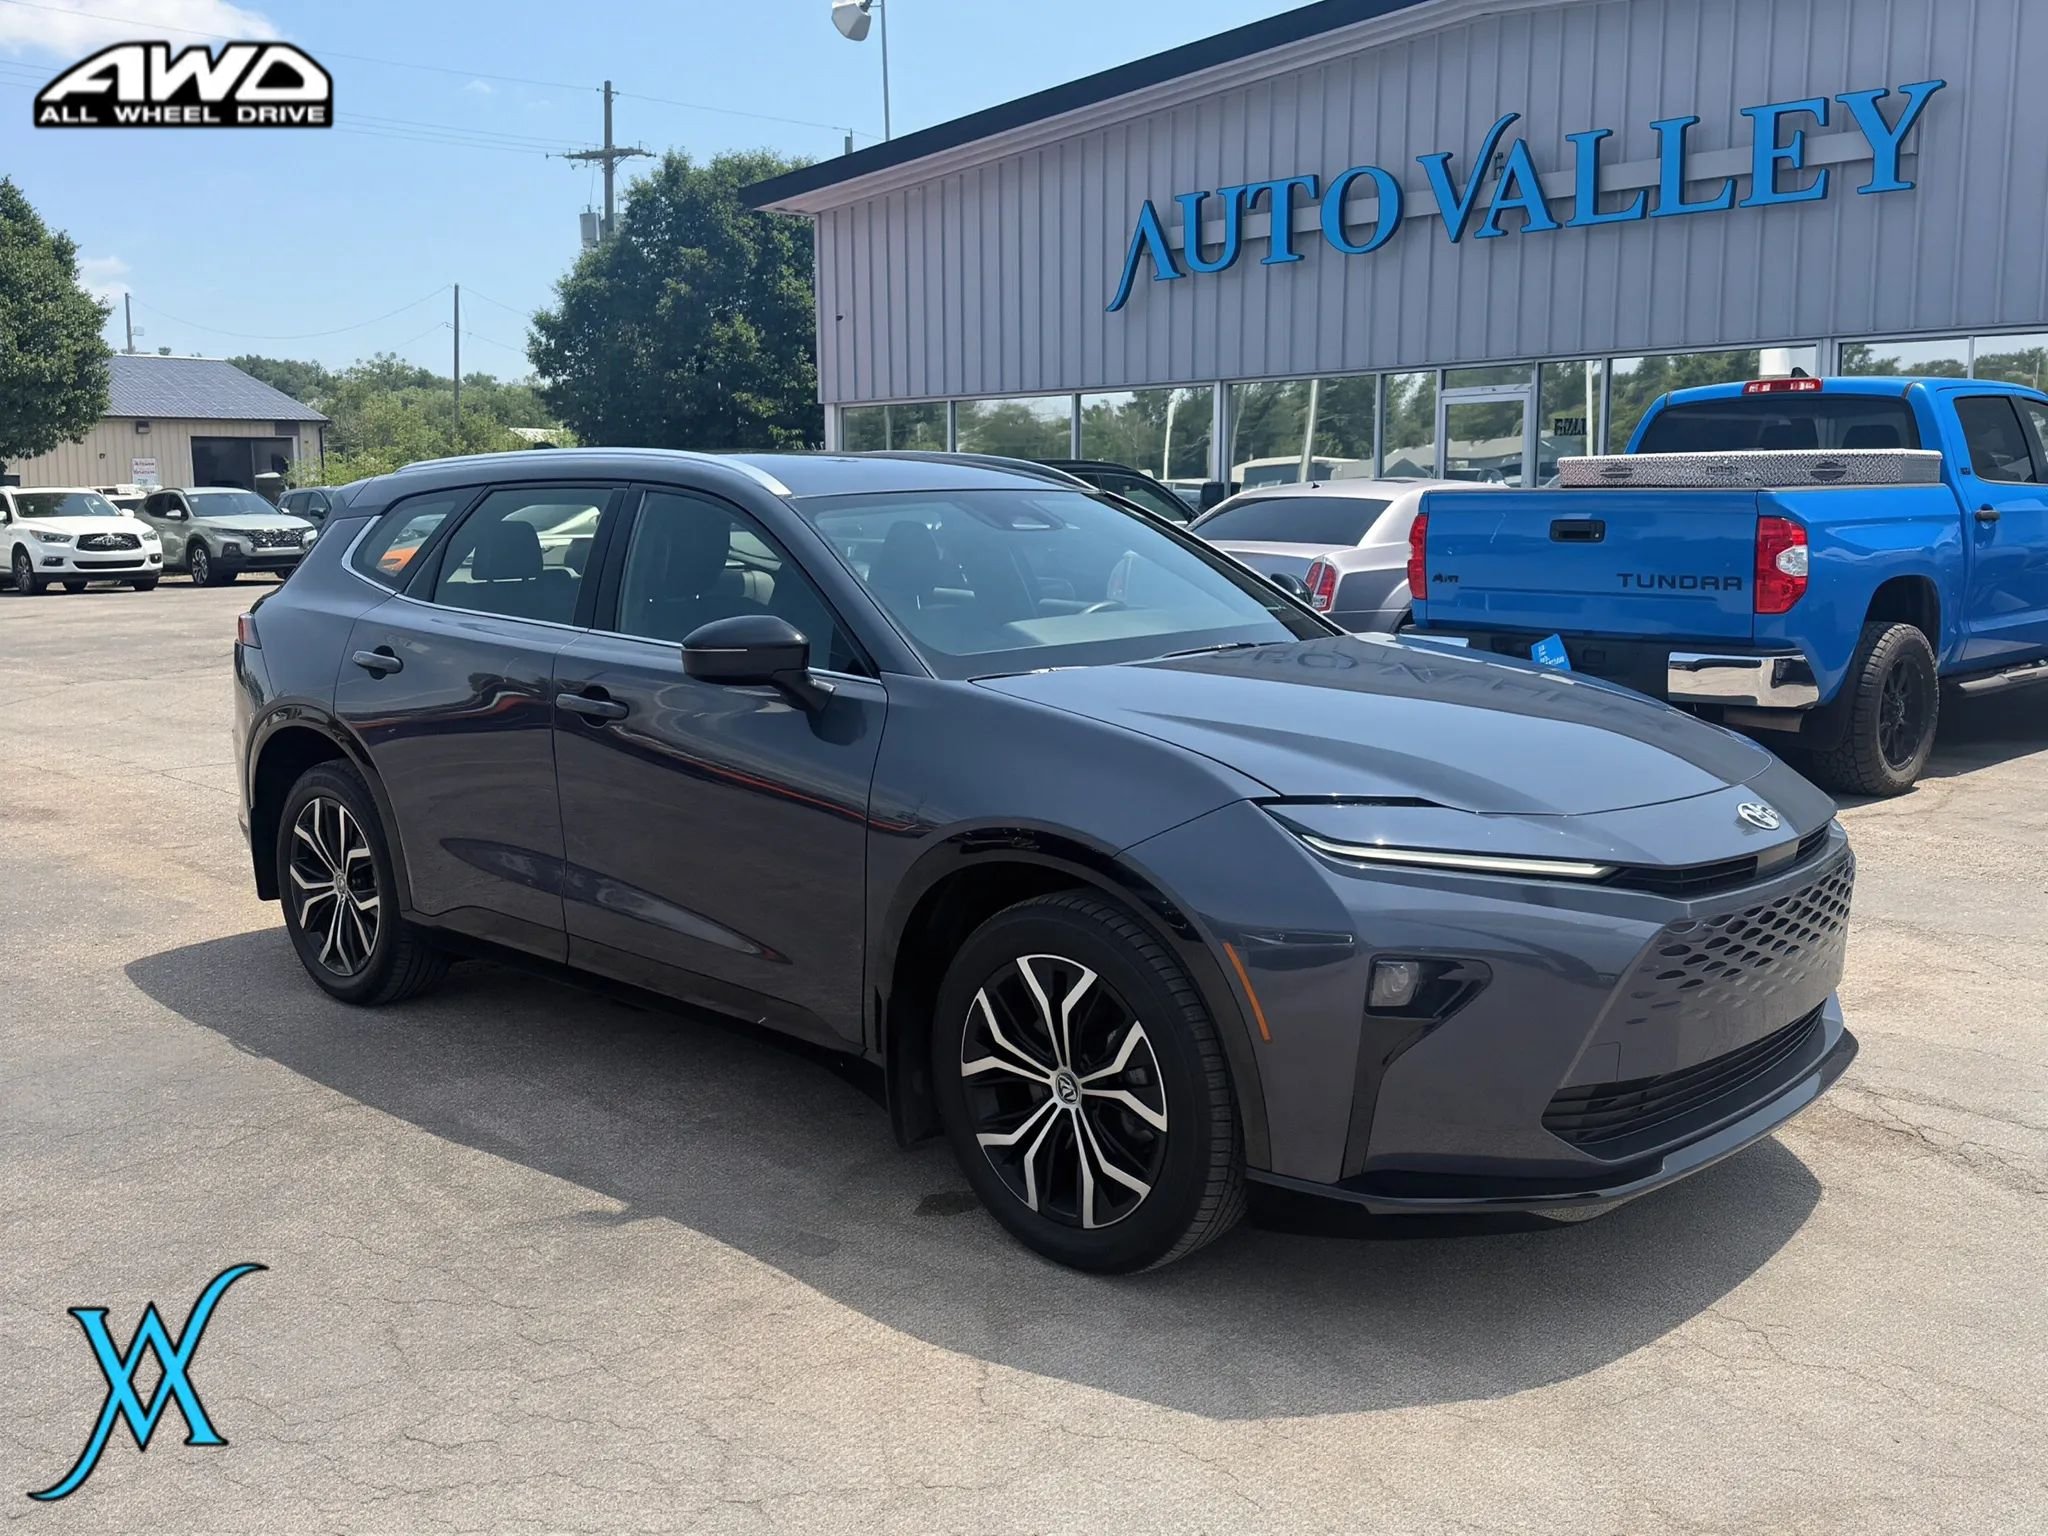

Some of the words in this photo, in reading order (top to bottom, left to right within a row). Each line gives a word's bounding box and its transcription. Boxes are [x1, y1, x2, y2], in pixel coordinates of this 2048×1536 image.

[1105, 166, 1401, 312] AUTO
[1416, 78, 1945, 243] VALLEY
[1616, 573, 1743, 591] TUNDRA
